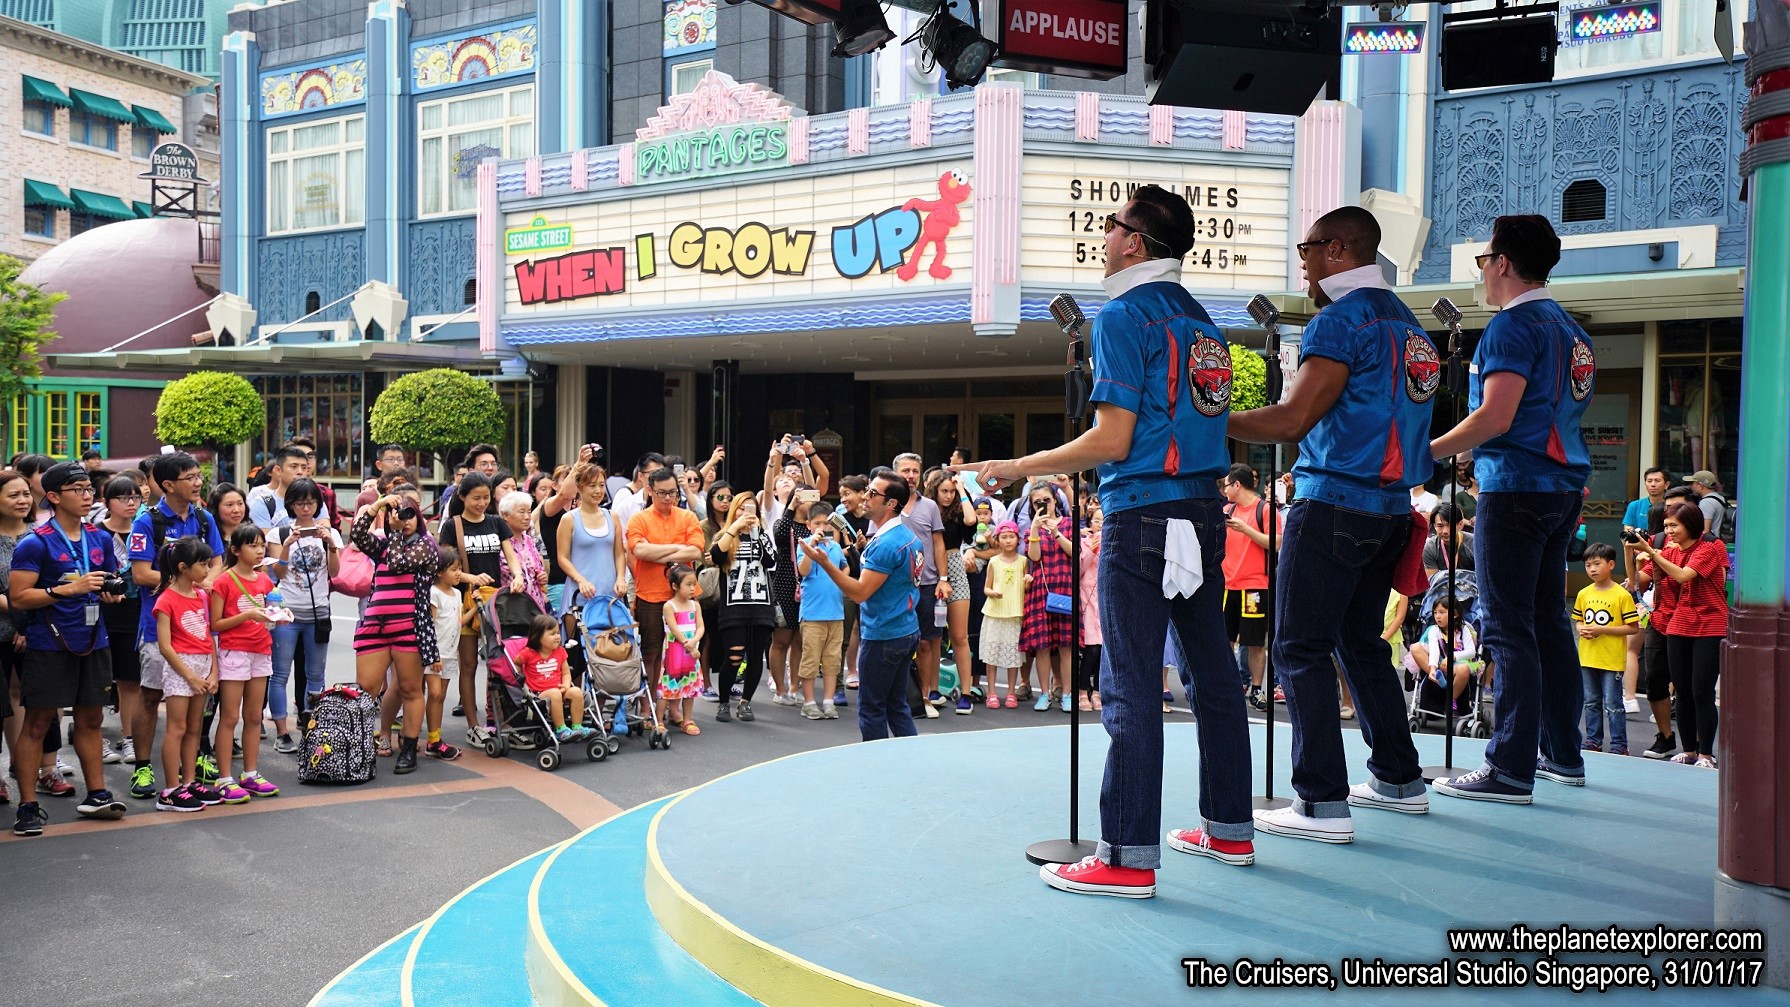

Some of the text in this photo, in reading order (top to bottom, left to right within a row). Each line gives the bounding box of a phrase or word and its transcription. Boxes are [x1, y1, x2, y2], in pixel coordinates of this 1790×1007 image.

[1010, 9, 1120, 46] APPLAUSE
[153, 153, 196, 168] BROWN
[166, 145, 182, 155] The
[639, 128, 786, 177] PANTAGES
[157, 165, 194, 179] DERBY
[1070, 179, 1239, 208] SHOWMES
[535, 217, 544, 226] 123
[1238, 223, 1252, 235] PM
[509, 228, 570, 250] SESAME STREET
[514, 205, 922, 306] WHEN I GROW UP
[1233, 254, 1247, 266] PM
[1190, 338, 1231, 367] Cruisers
[730, 560, 768, 601] 72
